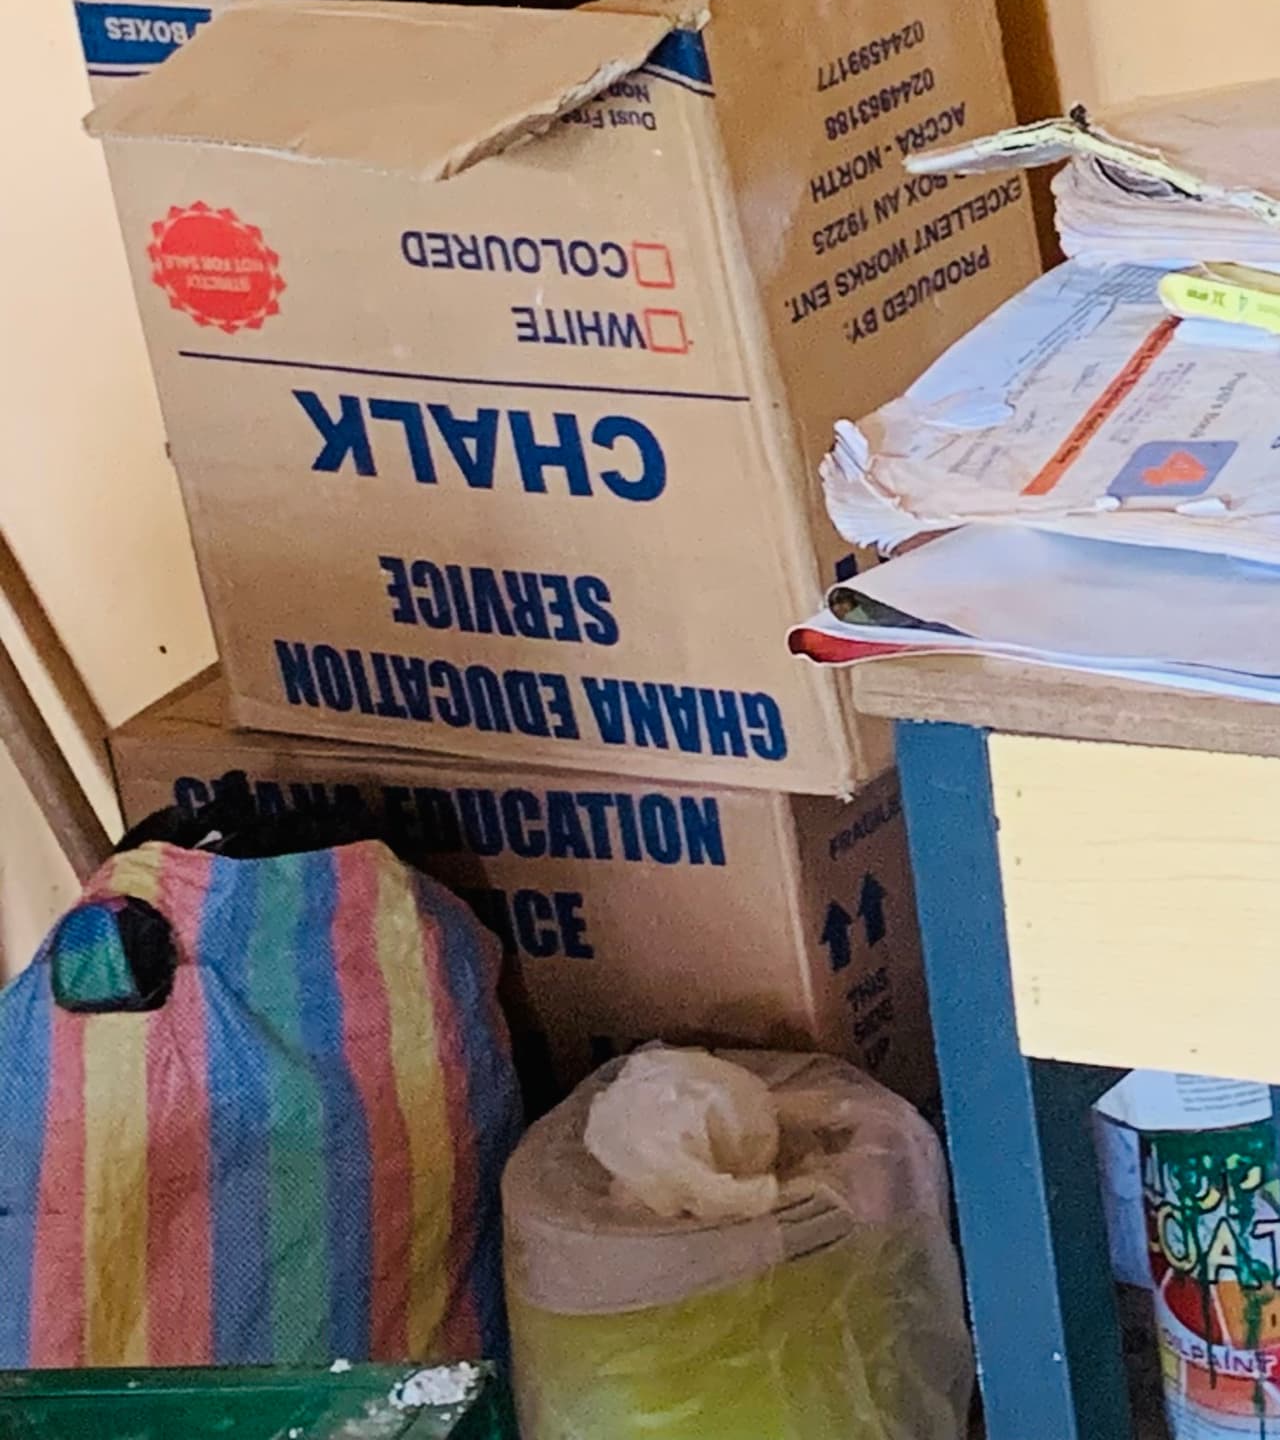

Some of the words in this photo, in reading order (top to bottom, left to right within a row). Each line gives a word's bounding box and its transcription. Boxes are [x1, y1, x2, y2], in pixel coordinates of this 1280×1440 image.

[103, 16, 188, 45] BOXES
[608, 109, 656, 130] Dust
[896, 102, 966, 155] ACCRA
[810, 149, 883, 203] NORTH
[905, 173, 948, 206] BOX
[813, 210, 868, 255] 19225
[874, 191, 899, 225] AN
[914, 175, 1022, 254] EXCELLENT
[402, 230, 629, 280] COLOURED
[836, 238, 909, 297] WORKS
[785, 281, 830, 323] ENT.
[883, 245, 990, 323] PRODUCED
[513, 306, 647, 350] WHITE
[291, 388, 667, 503] CHALK
[378, 556, 620, 647] SERVICE
[274, 639, 581, 741] EDUCATION
[581, 677, 788, 762] GHANA
[382, 783, 726, 866] EDUCATION
